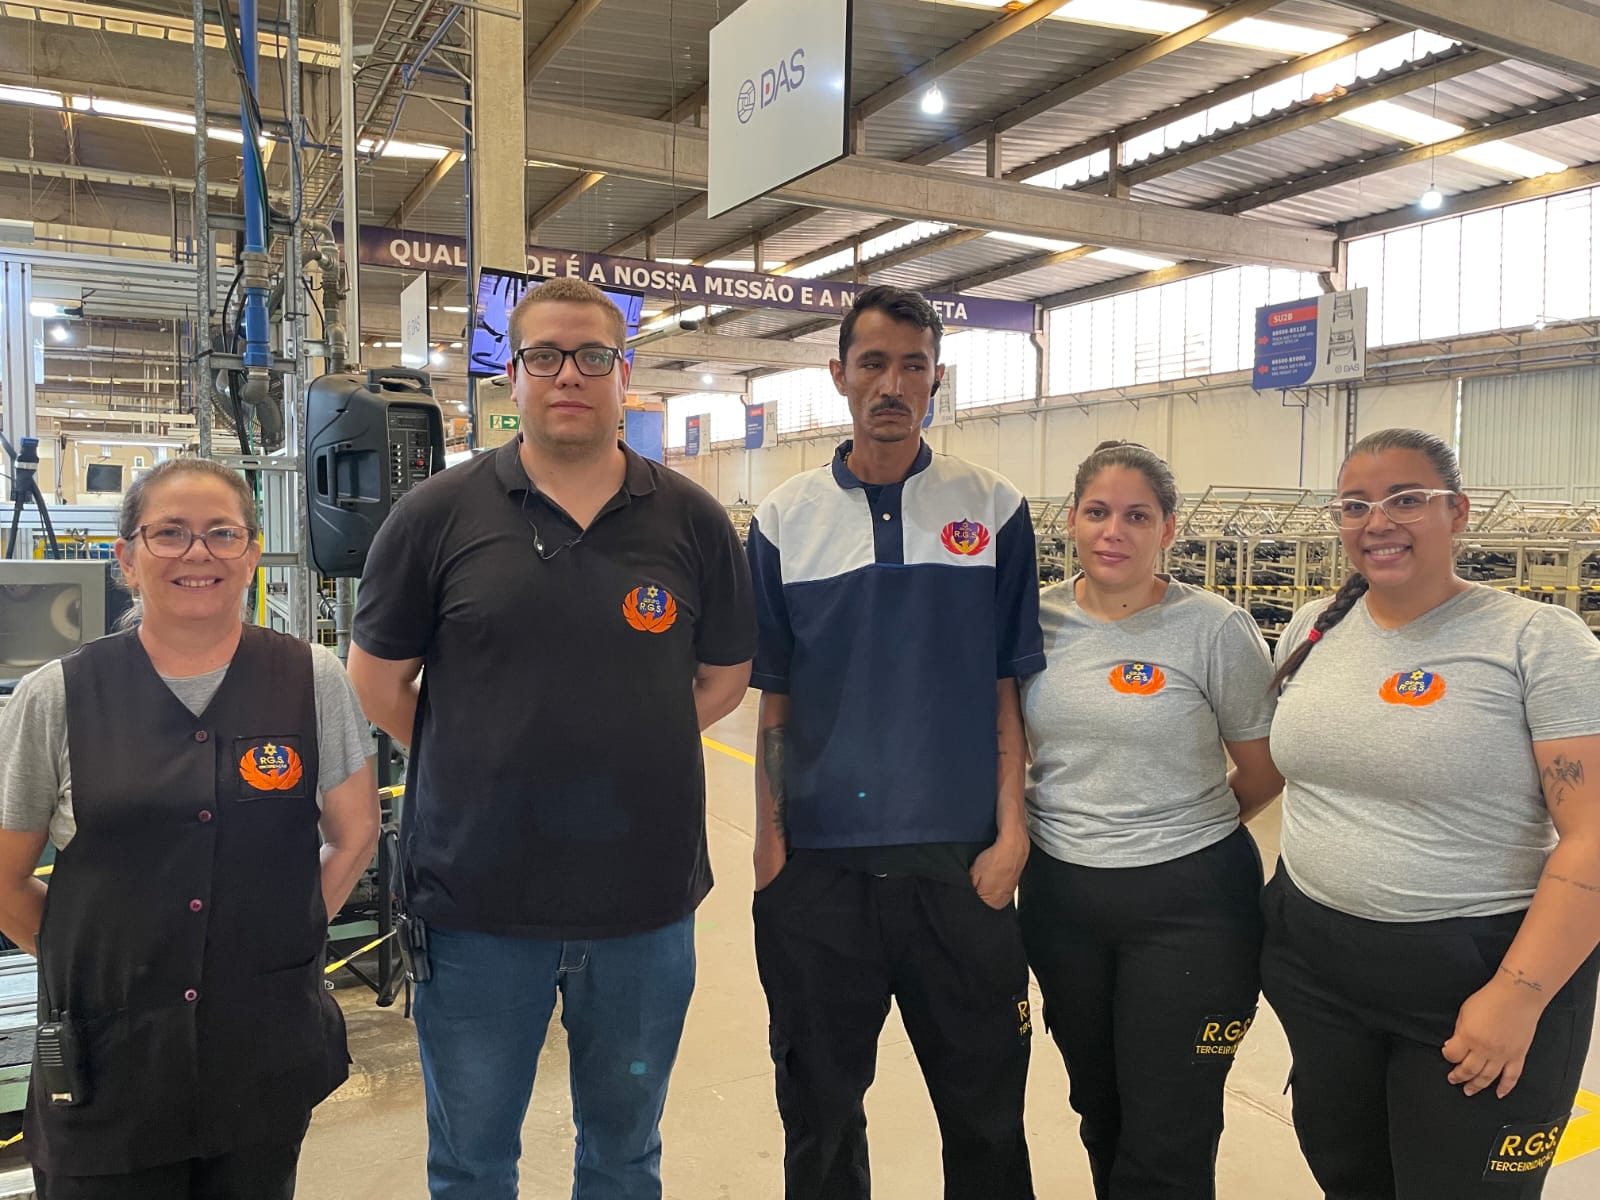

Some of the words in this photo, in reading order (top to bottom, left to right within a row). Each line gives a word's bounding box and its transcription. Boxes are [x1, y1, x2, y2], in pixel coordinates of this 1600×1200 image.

[760, 48, 805, 110] DAS
[566, 254, 583, 280] É
[588, 263, 606, 283] A
[614, 265, 698, 293] NOSSA
[704, 275, 794, 303] MISSÃO
[801, 287, 814, 305] E
[818, 289, 834, 307] A
[927, 299, 968, 320] ETA
